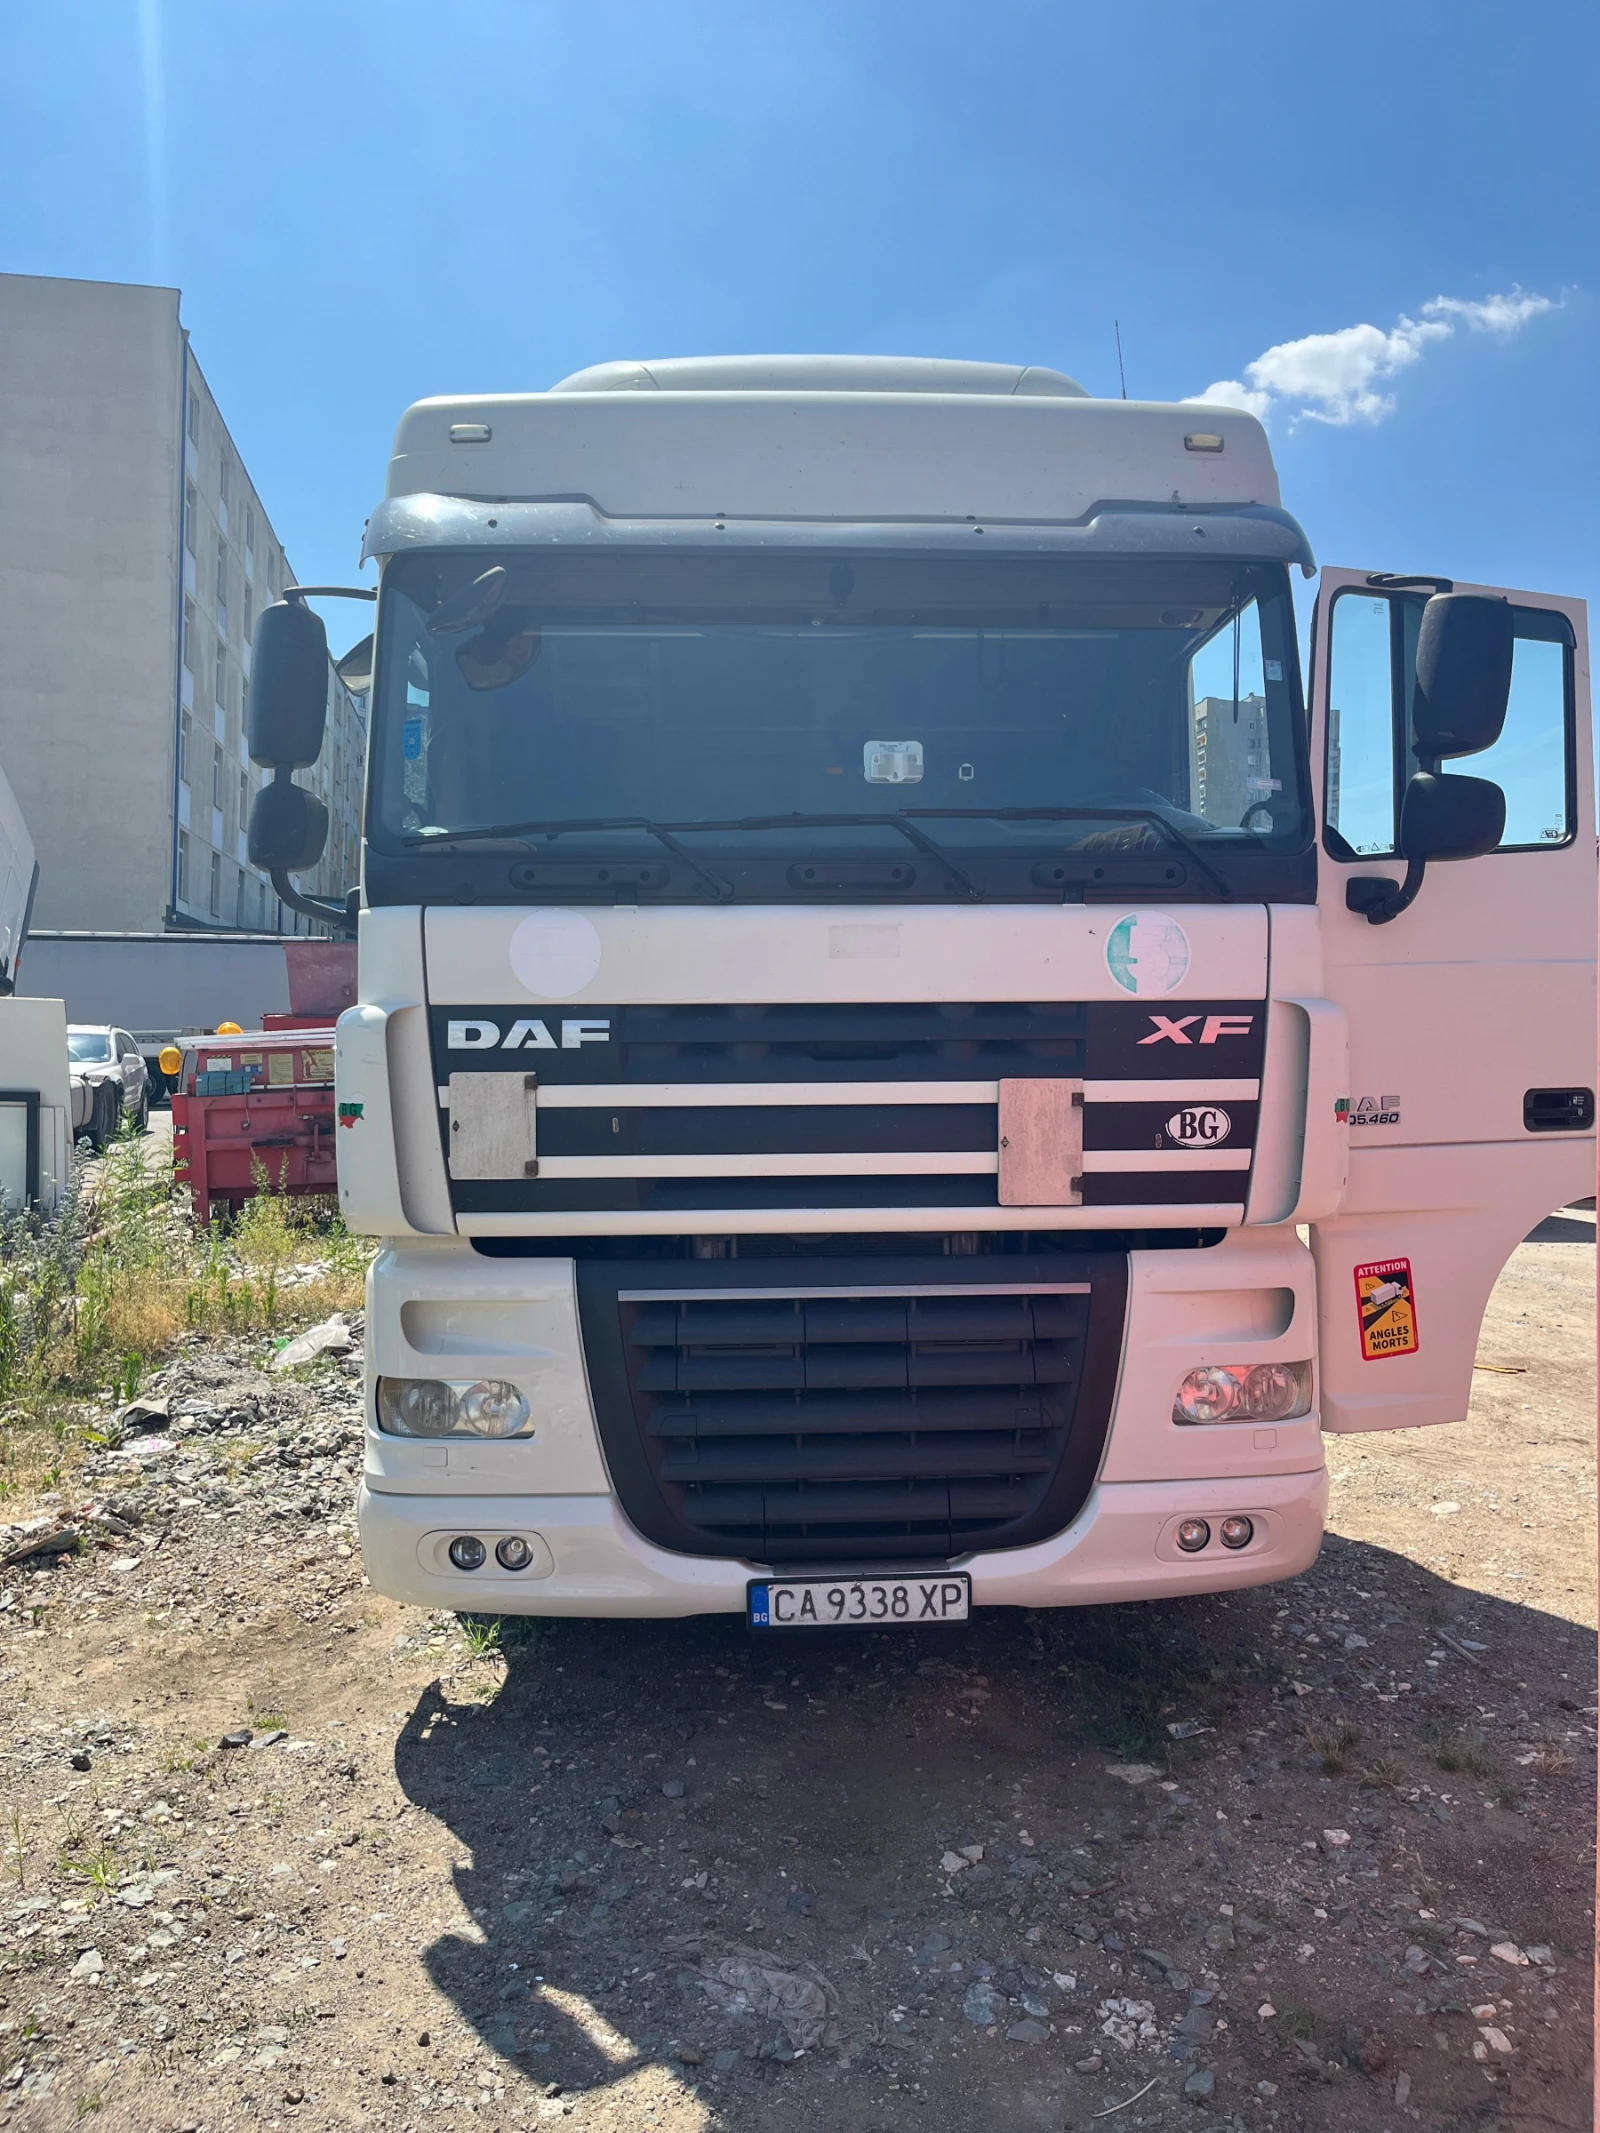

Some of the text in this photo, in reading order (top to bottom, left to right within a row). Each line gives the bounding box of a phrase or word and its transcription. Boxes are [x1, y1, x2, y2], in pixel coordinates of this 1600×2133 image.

[448, 1020, 610, 1049] DAF
[1137, 1015, 1254, 1044] XF
[341, 1103, 357, 1116] BG
[1178, 1110, 1219, 1140] BG
[1358, 1261, 1407, 1276] ATTENTION
[1370, 1326, 1409, 1340] ANGLES
[1373, 1336, 1408, 1350] MORTS
[774, 1583, 962, 1622] CA 9338 XP
[753, 1612, 768, 1623] BG
